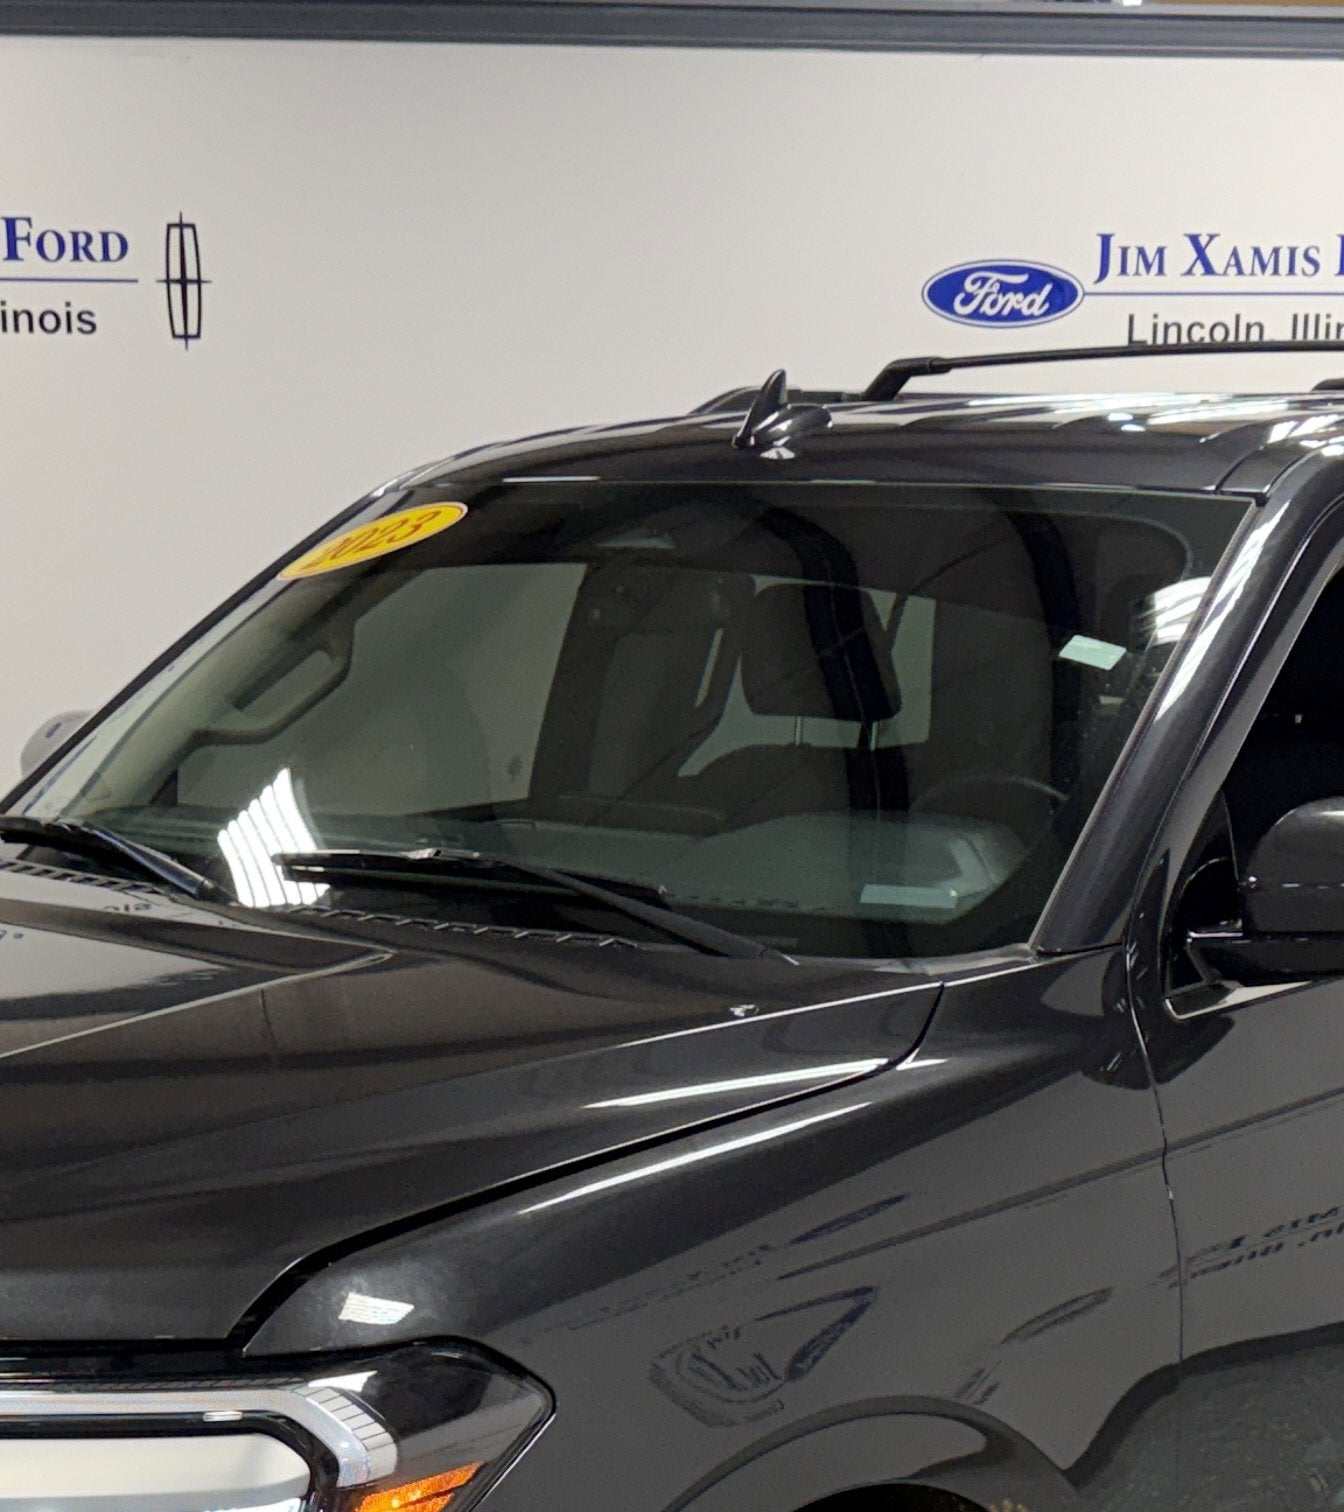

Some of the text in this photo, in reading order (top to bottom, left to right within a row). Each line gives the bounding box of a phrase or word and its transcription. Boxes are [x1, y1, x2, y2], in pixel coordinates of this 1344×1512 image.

[0, 216, 129, 263] FORD
[1092, 232, 1167, 286] JIM
[1180, 232, 1321, 278] XAMIS
[954, 271, 1051, 319] Ford
[1127, 312, 1275, 346] Lincoln
